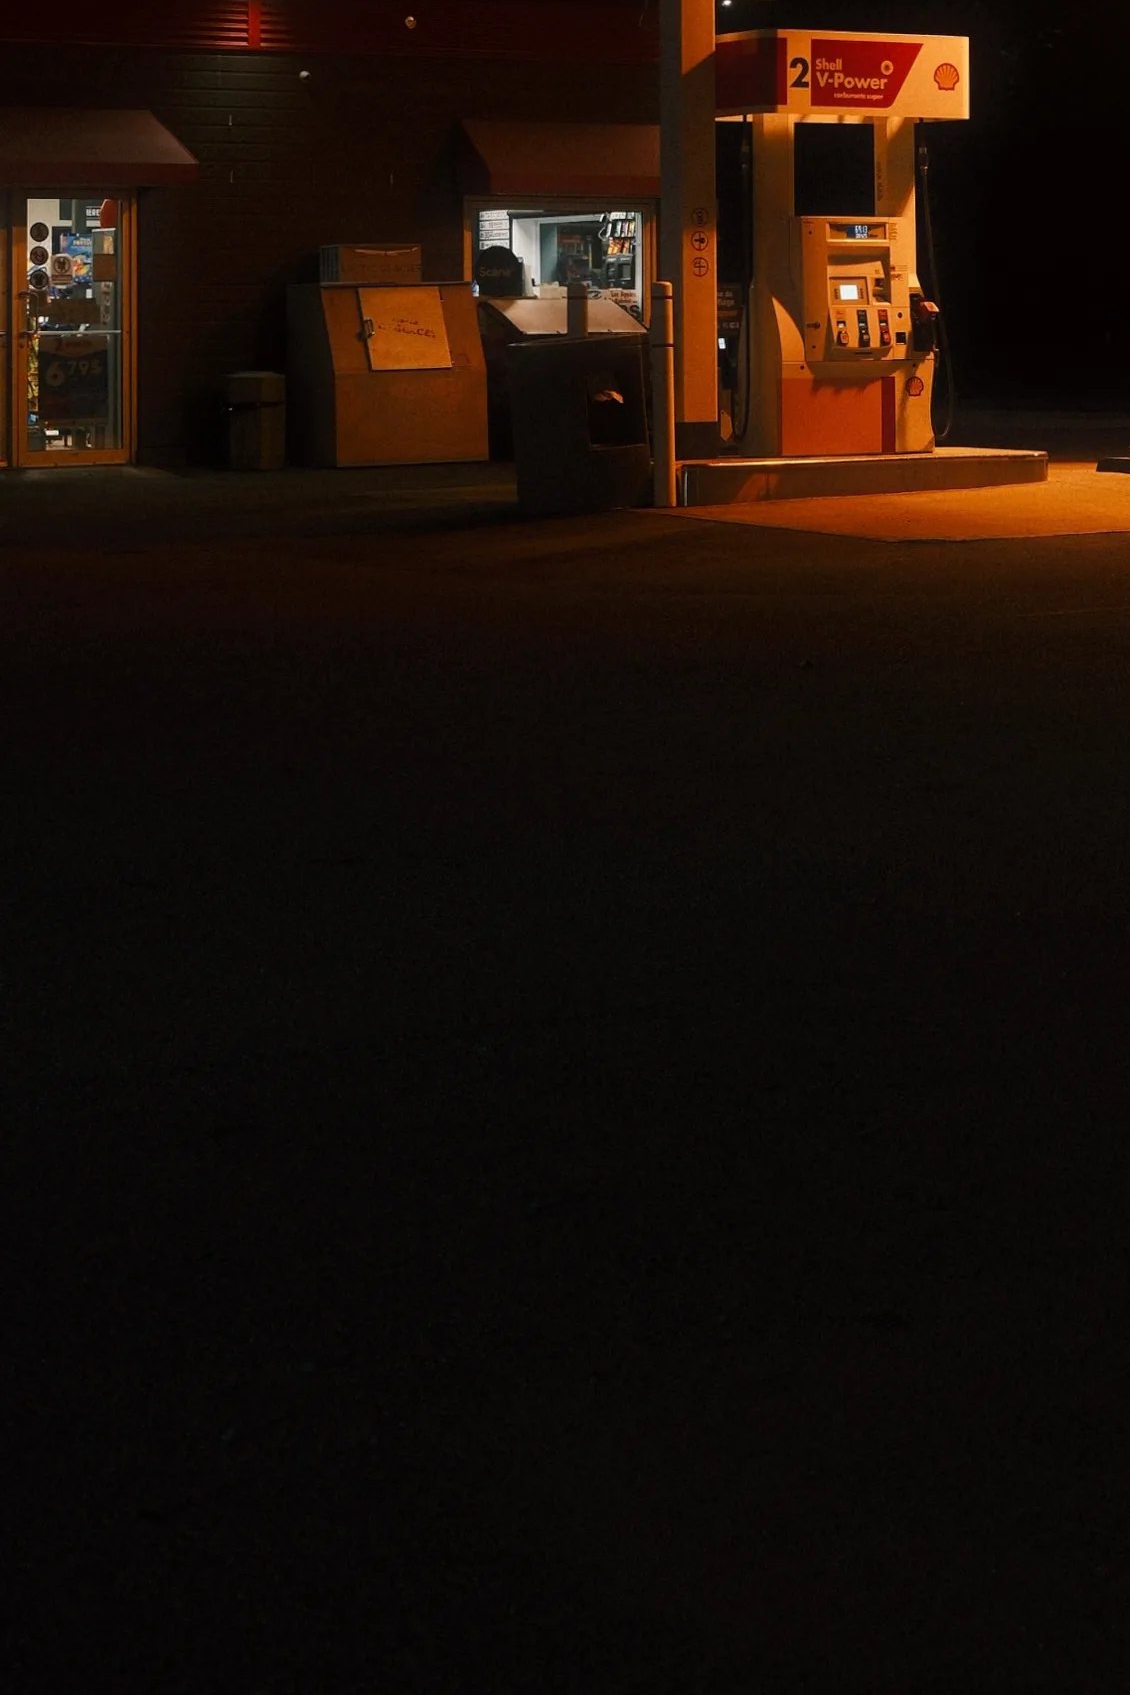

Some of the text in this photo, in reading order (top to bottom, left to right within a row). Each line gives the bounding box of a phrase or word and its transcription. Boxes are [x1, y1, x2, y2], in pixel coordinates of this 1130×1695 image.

[789, 57, 810, 88] 2
[815, 58, 843, 71] Shell
[815, 71, 888, 90] V-Power
